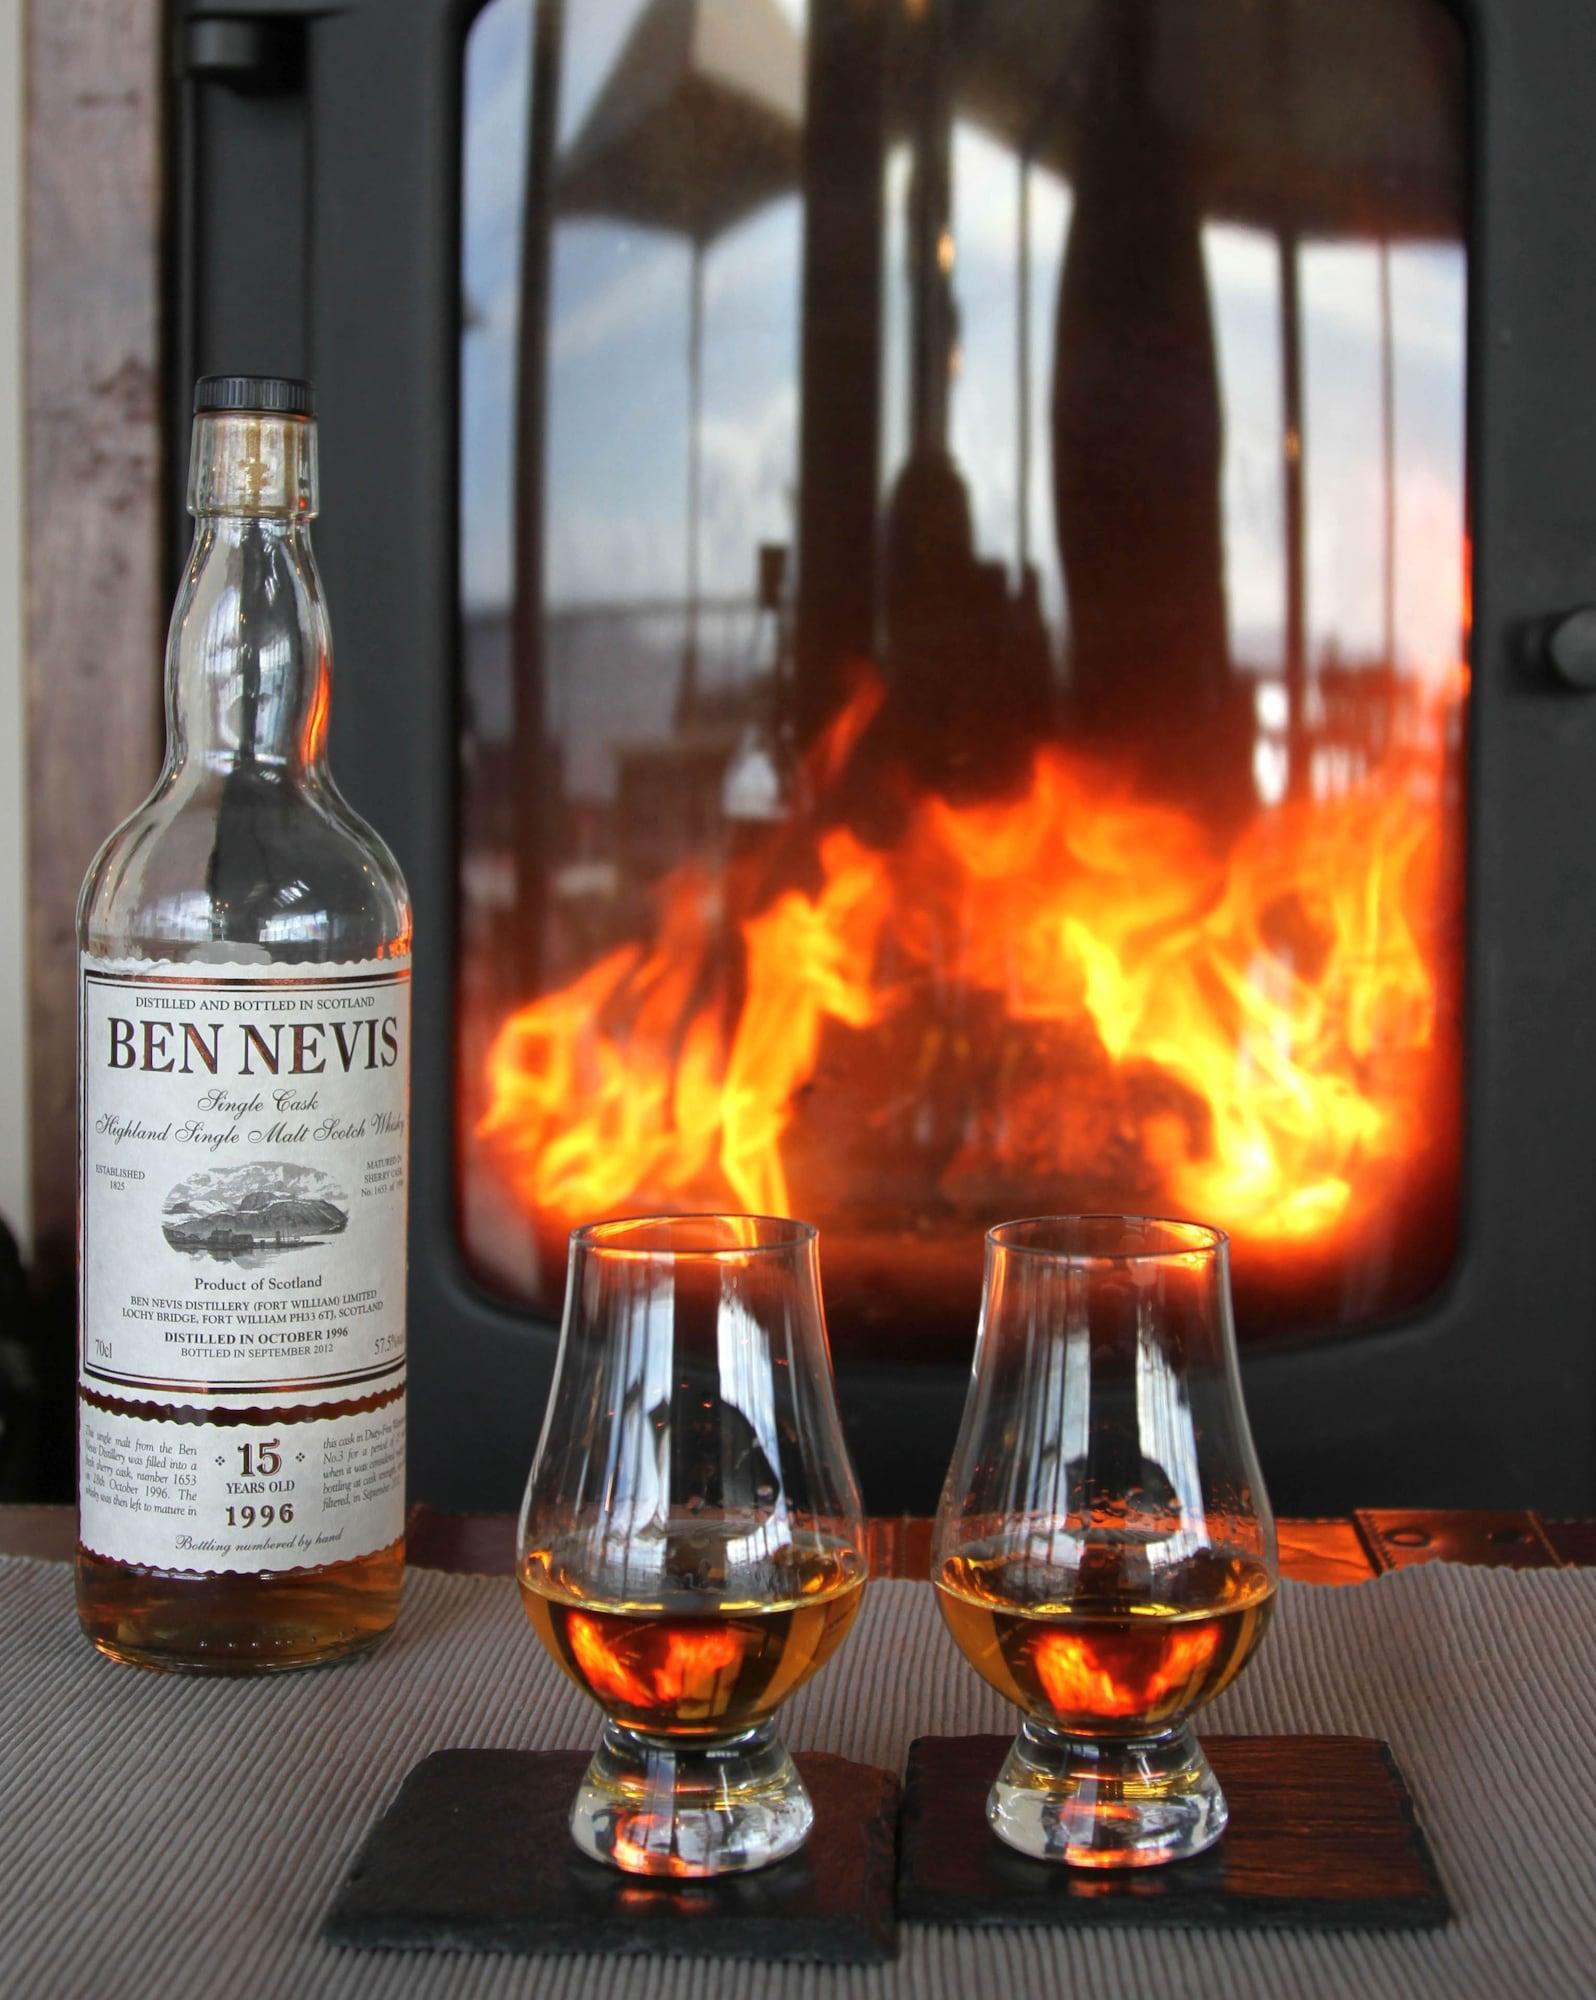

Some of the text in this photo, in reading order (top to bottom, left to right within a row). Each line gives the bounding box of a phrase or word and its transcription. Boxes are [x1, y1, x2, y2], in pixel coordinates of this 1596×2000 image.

[135, 996, 375, 1011] DISTILLED AND BOTTLED IN SCOTLAND
[107, 1016, 398, 1075] BEN NEVIS
[197, 1088, 319, 1121] Single Cask
[95, 1113, 172, 1145] Highland
[175, 1120, 240, 1152] Single
[248, 1122, 310, 1144] Malt
[313, 1118, 366, 1141] Scotch
[95, 1164, 146, 1180] ESTABLISHED
[110, 1180, 125, 1191] 1825
[194, 1275, 322, 1291] Product of Scotland
[130, 1290, 377, 1312] BEN NEVIS DISTILLERY (FORT WILLIAM) LIMITED
[122, 1302, 384, 1324] LOCHY BRIDGE, FORT WILLIAM PH33 6TJ, SCOTLAND
[164, 1327, 349, 1344] DISTILLED IN OCTOBER 1996
[95, 1339, 112, 1359] 70cl
[180, 1344, 334, 1358] BOTTLED IN SEPTEMBER 2012
[115, 1436, 131, 1448] malt
[135, 1438, 154, 1452] from
[160, 1442, 173, 1454] the
[178, 1444, 197, 1456] Ben
[323, 1436, 337, 1449] this
[338, 1432, 355, 1446] cask
[98, 1445, 126, 1464] Distillery
[128, 1456, 143, 1466] was
[145, 1455, 166, 1470] filled
[170, 1459, 187, 1470] into
[190, 1462, 197, 1470] a
[236, 1438, 283, 1478] 15
[324, 1450, 344, 1464] No.3
[348, 1448, 359, 1462] for
[116, 1466, 134, 1480] cask,
[136, 1471, 168, 1484] number
[174, 1473, 197, 1486] 1653
[323, 1466, 344, 1479] when
[109, 1478, 138, 1495] October
[145, 1485, 170, 1500] 1996.
[178, 1488, 197, 1500] The
[226, 1480, 295, 1494] YEARS OLD
[322, 1480, 352, 1494] bottling
[353, 1480, 360, 1488] at
[113, 1494, 128, 1508] then
[130, 1497, 142, 1512] left
[144, 1502, 152, 1512] to
[154, 1505, 185, 1516] mature
[188, 1505, 197, 1516] in
[322, 1492, 351, 1512] filtered,
[225, 1503, 295, 1528] 1996
[175, 1527, 345, 1557] Bottling numbered by hand
